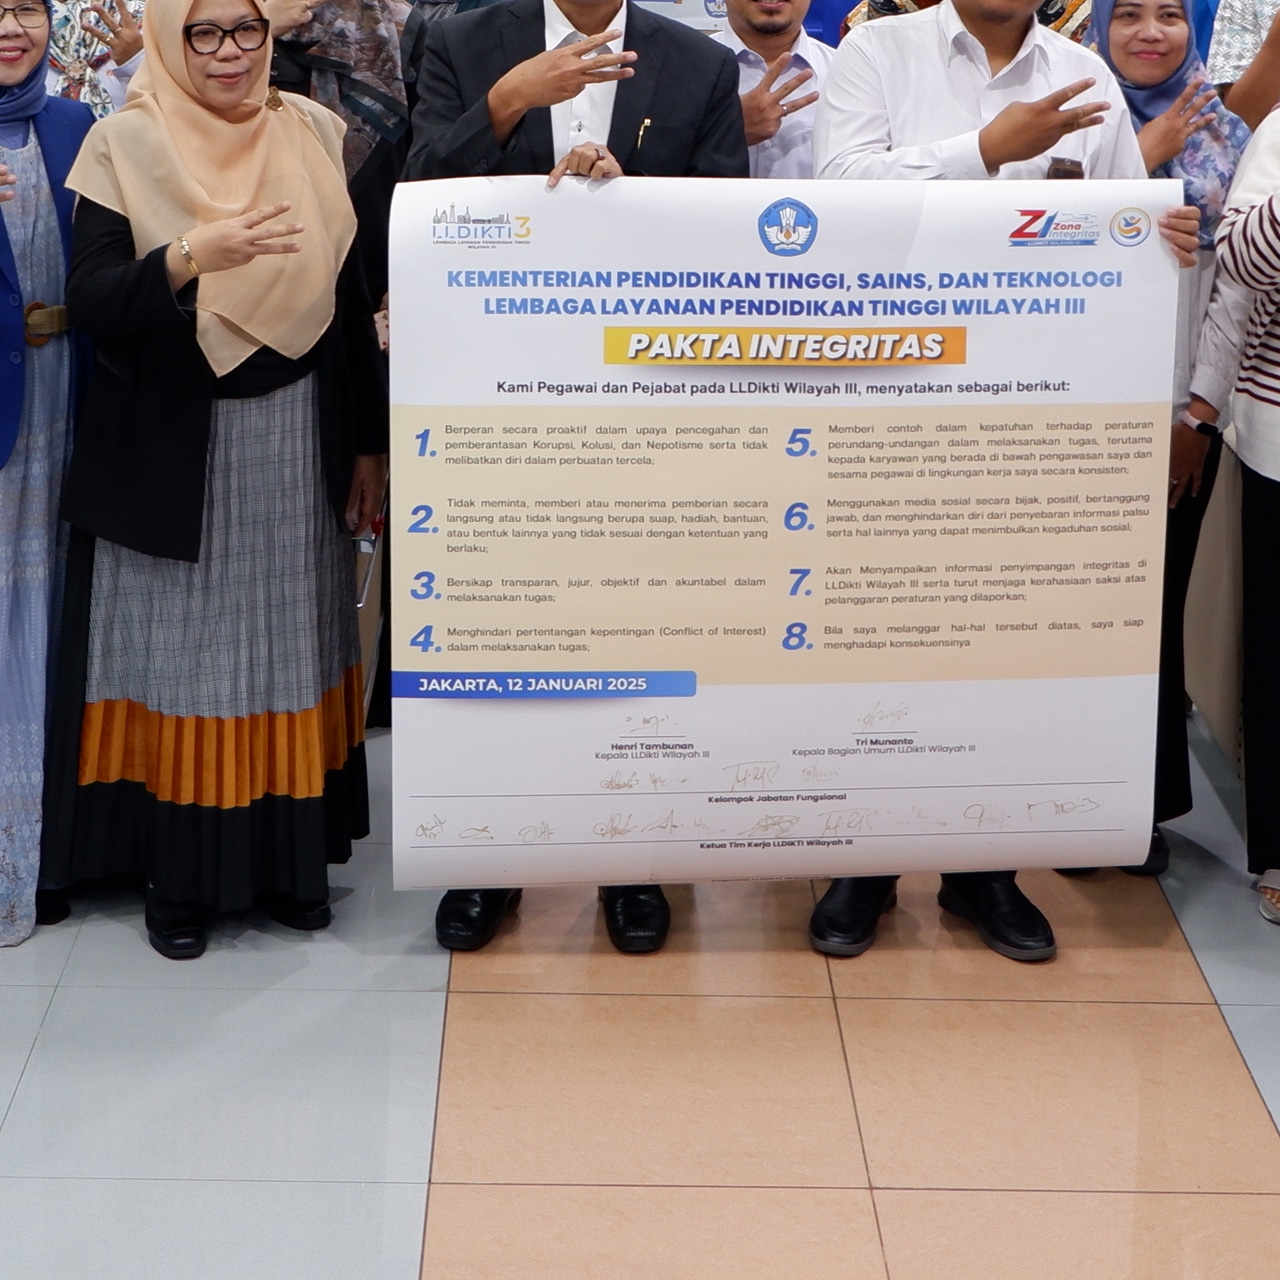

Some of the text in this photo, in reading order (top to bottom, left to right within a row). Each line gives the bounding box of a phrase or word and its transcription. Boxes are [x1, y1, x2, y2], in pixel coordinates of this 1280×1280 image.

[1053, 223, 1082, 231] Zona
[1048, 230, 1101, 239] Integritas
[447, 270, 1122, 290] KEMENTERIAN PENDIDIKAN TINGGI, SAINS, DAN TEKNOLOGI
[484, 297, 1085, 316] LEMBAGA LAYANAN PENDIDIKAN TINGGI WILAYAH III
[627, 333, 943, 358] PAKTA INTEGRITAS
[496, 380, 1070, 396] Kami Pegawai dan Pejabat pada LLDikti Wilayah III, menyatakan sebagai berikut:
[444, 424, 768, 436] Berperan secara proaktif dalam upaya pencegahan dan
[827, 421, 1154, 434] Memberi contoh dalam kepatuhan terhadap peraturan
[414, 429, 437, 457] 1.
[444, 440, 768, 450] pemberantasan Korupsi, Kolusi, dan Nepotisme serta tidak
[785, 428, 818, 457] 5.
[444, 455, 654, 465] melibatkan diri dalam perbuatan tercela;
[446, 497, 768, 509] Tidak meminta, memberi atau menerima pemberian secara
[407, 504, 439, 533] 2.
[446, 513, 768, 524] langsung atau tidak langsung berupa suap, hadiah, bantuan,
[783, 502, 816, 531] 6.
[446, 528, 768, 539] atau bentuk lainnya yang tidak sesuai dengan ketentuan yang
[446, 544, 488, 553] berlaku;
[410, 571, 442, 600] 3.
[446, 577, 766, 588] Bersikap transparan, jujur, objektif dan akuntabel dalam
[788, 568, 812, 597] 7.
[446, 593, 556, 603] melaksanakan tugas;
[824, 592, 1027, 605] pelanggaran peraturan yang dilaporkan;
[446, 626, 766, 638] Menghindari pertentangan kepentingan (Conflict of Interest)
[823, 618, 1144, 635] Bila saya melanggar hal-hal tersebut diatas, saya siap
[409, 625, 442, 653] 4.
[781, 622, 814, 650] 8.
[446, 642, 590, 653] dalam melaksanakan tugas;
[823, 639, 970, 650] menghadapi konsekuensinya
[418, 677, 647, 691] JAKARTA, 12 JANUARI 2025
[610, 742, 694, 750] Henri Tambunan
[855, 737, 868, 746] Tri
[707, 795, 754, 804] Kelompok
[795, 793, 847, 802] Fungsional
